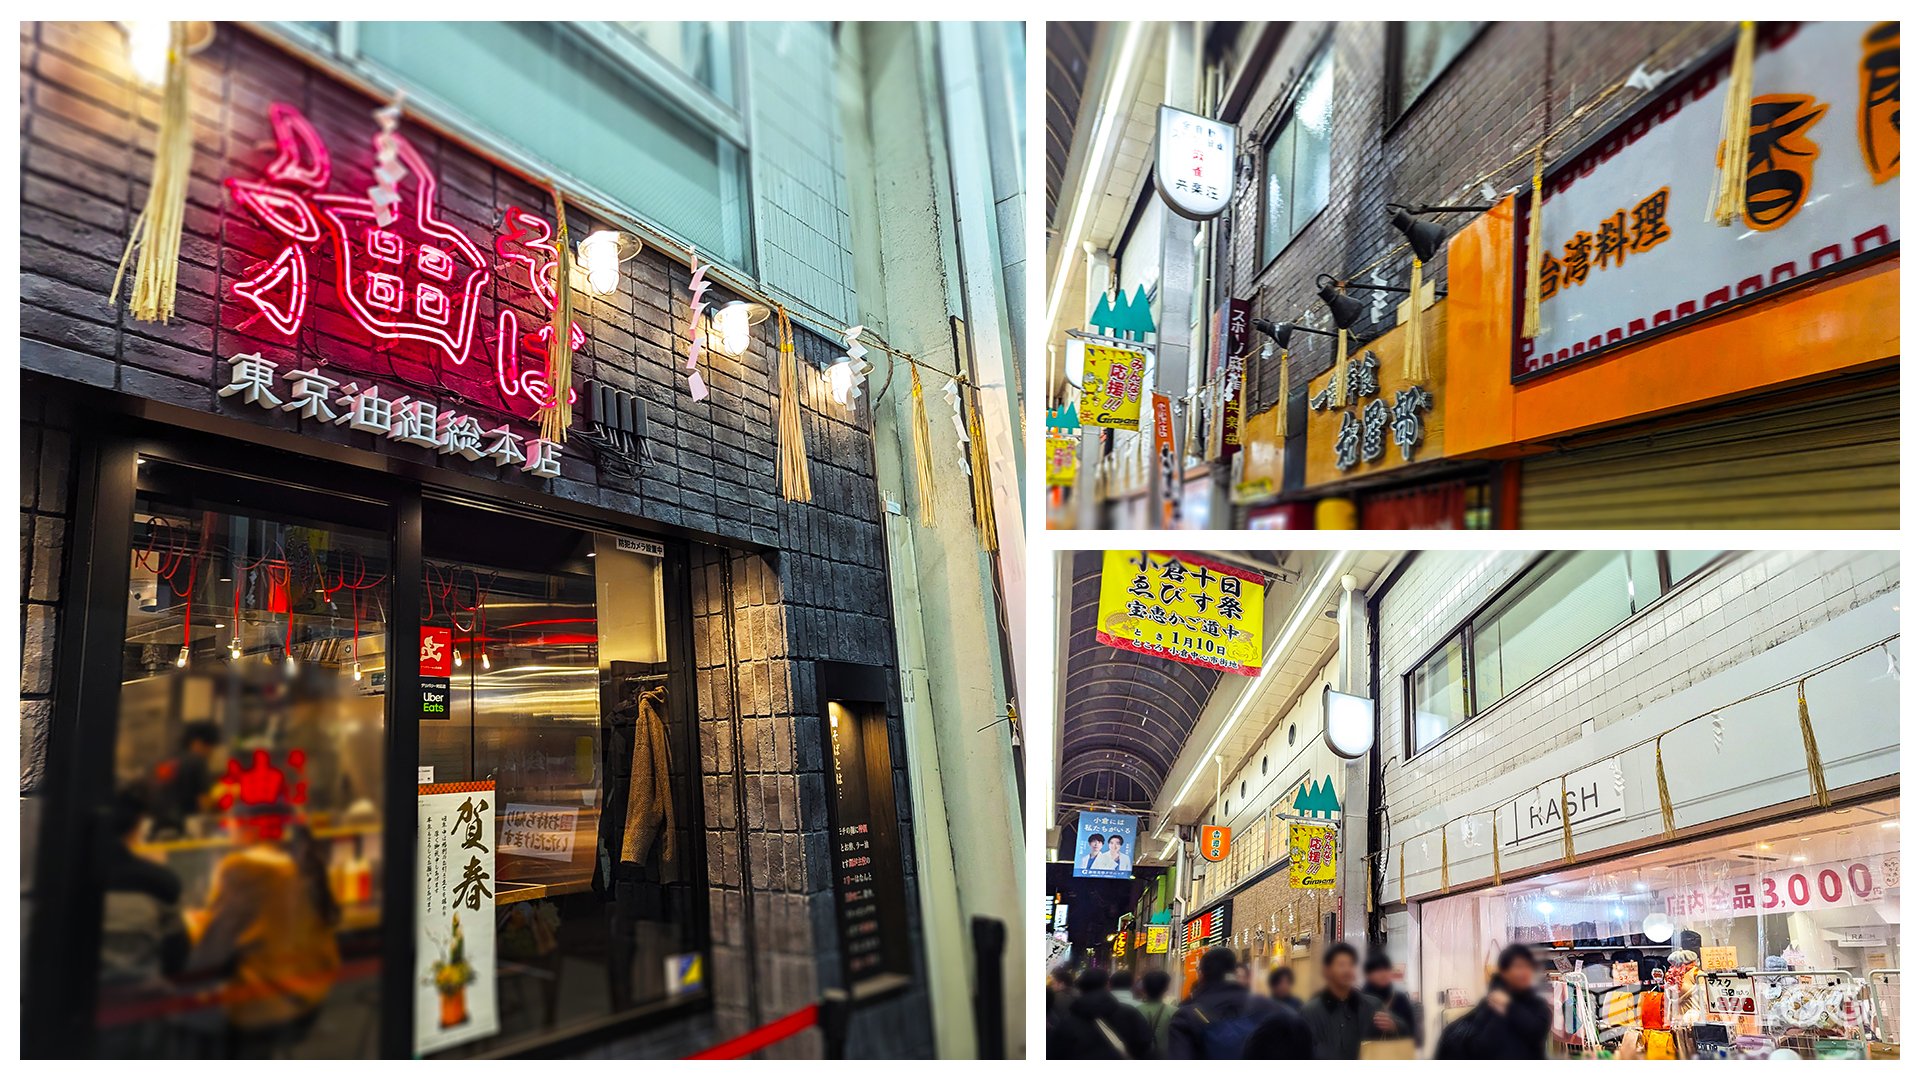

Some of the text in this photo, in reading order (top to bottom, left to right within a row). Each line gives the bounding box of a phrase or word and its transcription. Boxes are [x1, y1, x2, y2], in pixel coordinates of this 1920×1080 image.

[1538, 186, 1672, 303] 台湾料理
[217, 351, 565, 480] 東京油組総本店
[1129, 550, 1243, 598] 小倉十日
[1126, 574, 1244, 620] ゑびす祭
[1126, 599, 1242, 642] 宝恵かご道中
[1172, 631, 1227, 656] 1月10日
[423, 692, 444, 702] Uber
[423, 703, 444, 712] Eats
[1084, 824, 1131, 834] 私たちがいる
[1093, 817, 1125, 826] 小倉には
[451, 796, 493, 911] 賀春
[1708, 979, 1731, 988] マスク
